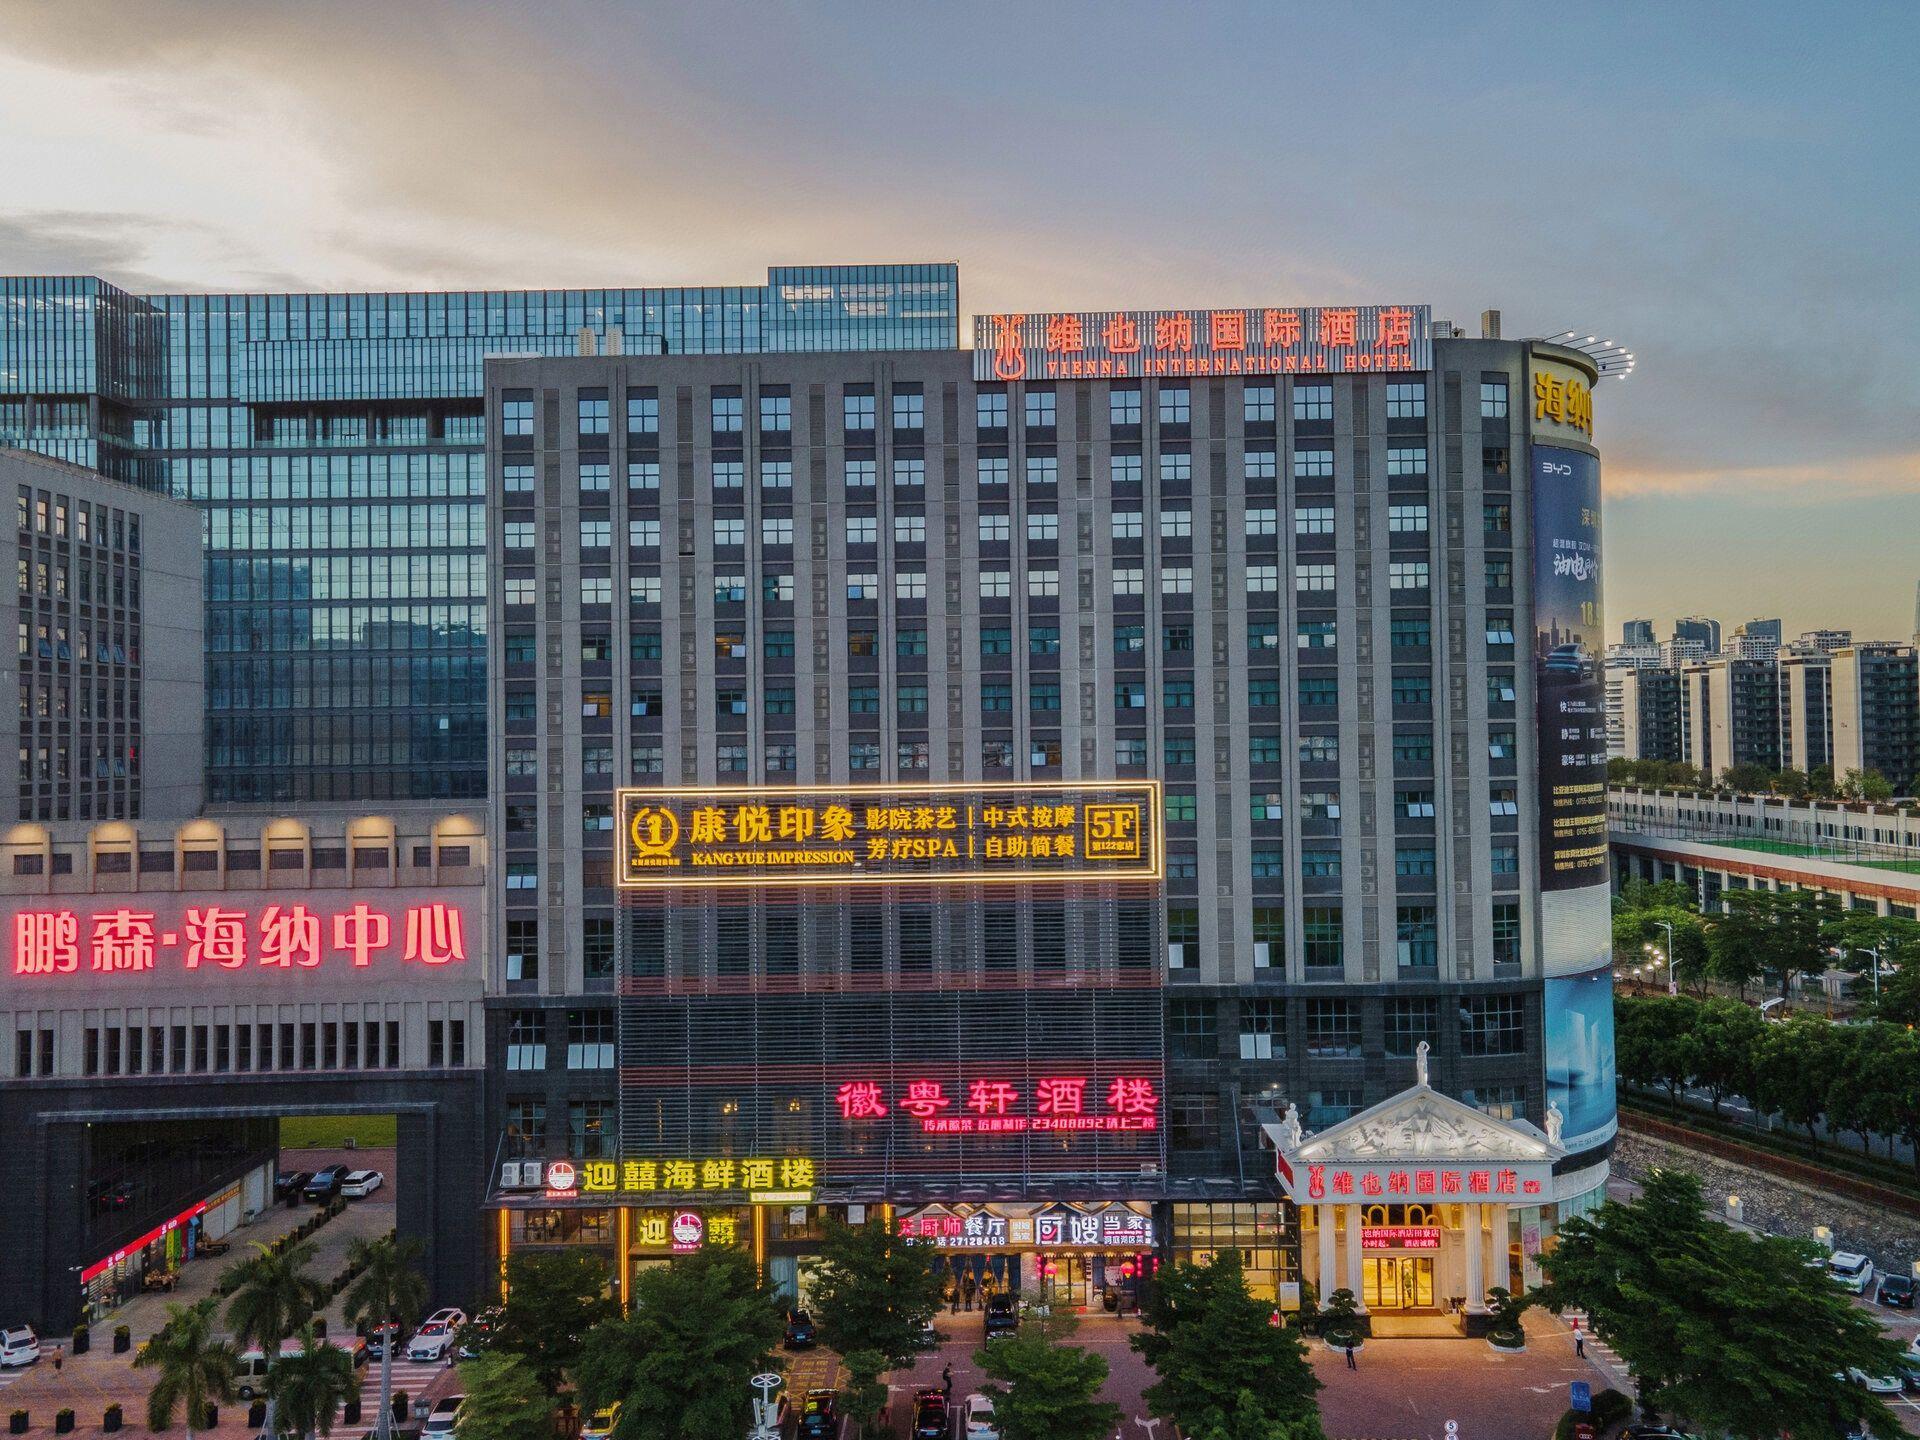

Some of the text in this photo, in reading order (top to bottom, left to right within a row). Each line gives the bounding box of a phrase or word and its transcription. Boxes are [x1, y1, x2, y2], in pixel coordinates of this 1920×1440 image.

[1047, 307, 1416, 354] 维也纳国际酒店
[1047, 353, 1414, 376] VIENNA INTERNATIONAL HOTEL
[1542, 461, 1572, 476] BYD
[690, 806, 856, 844] 康悦印象
[865, 805, 1076, 831] 影院茶艺 中式按摩
[1091, 810, 1135, 839] 5F
[766, 851, 855, 865] IMPRESSION
[866, 836, 1076, 860] 芳疗SPA 自助简餐
[15, 904, 466, 974] 鹏森·海纳中心
[836, 1078, 1159, 1118] 徽粤轩酒楼
[582, 1158, 815, 1192] 迎囍海鲜酒楼
[1332, 1168, 1518, 1196] 维也纳国际酒店
[640, 1218, 667, 1246] 迎
[1104, 1215, 1144, 1230] 当家
